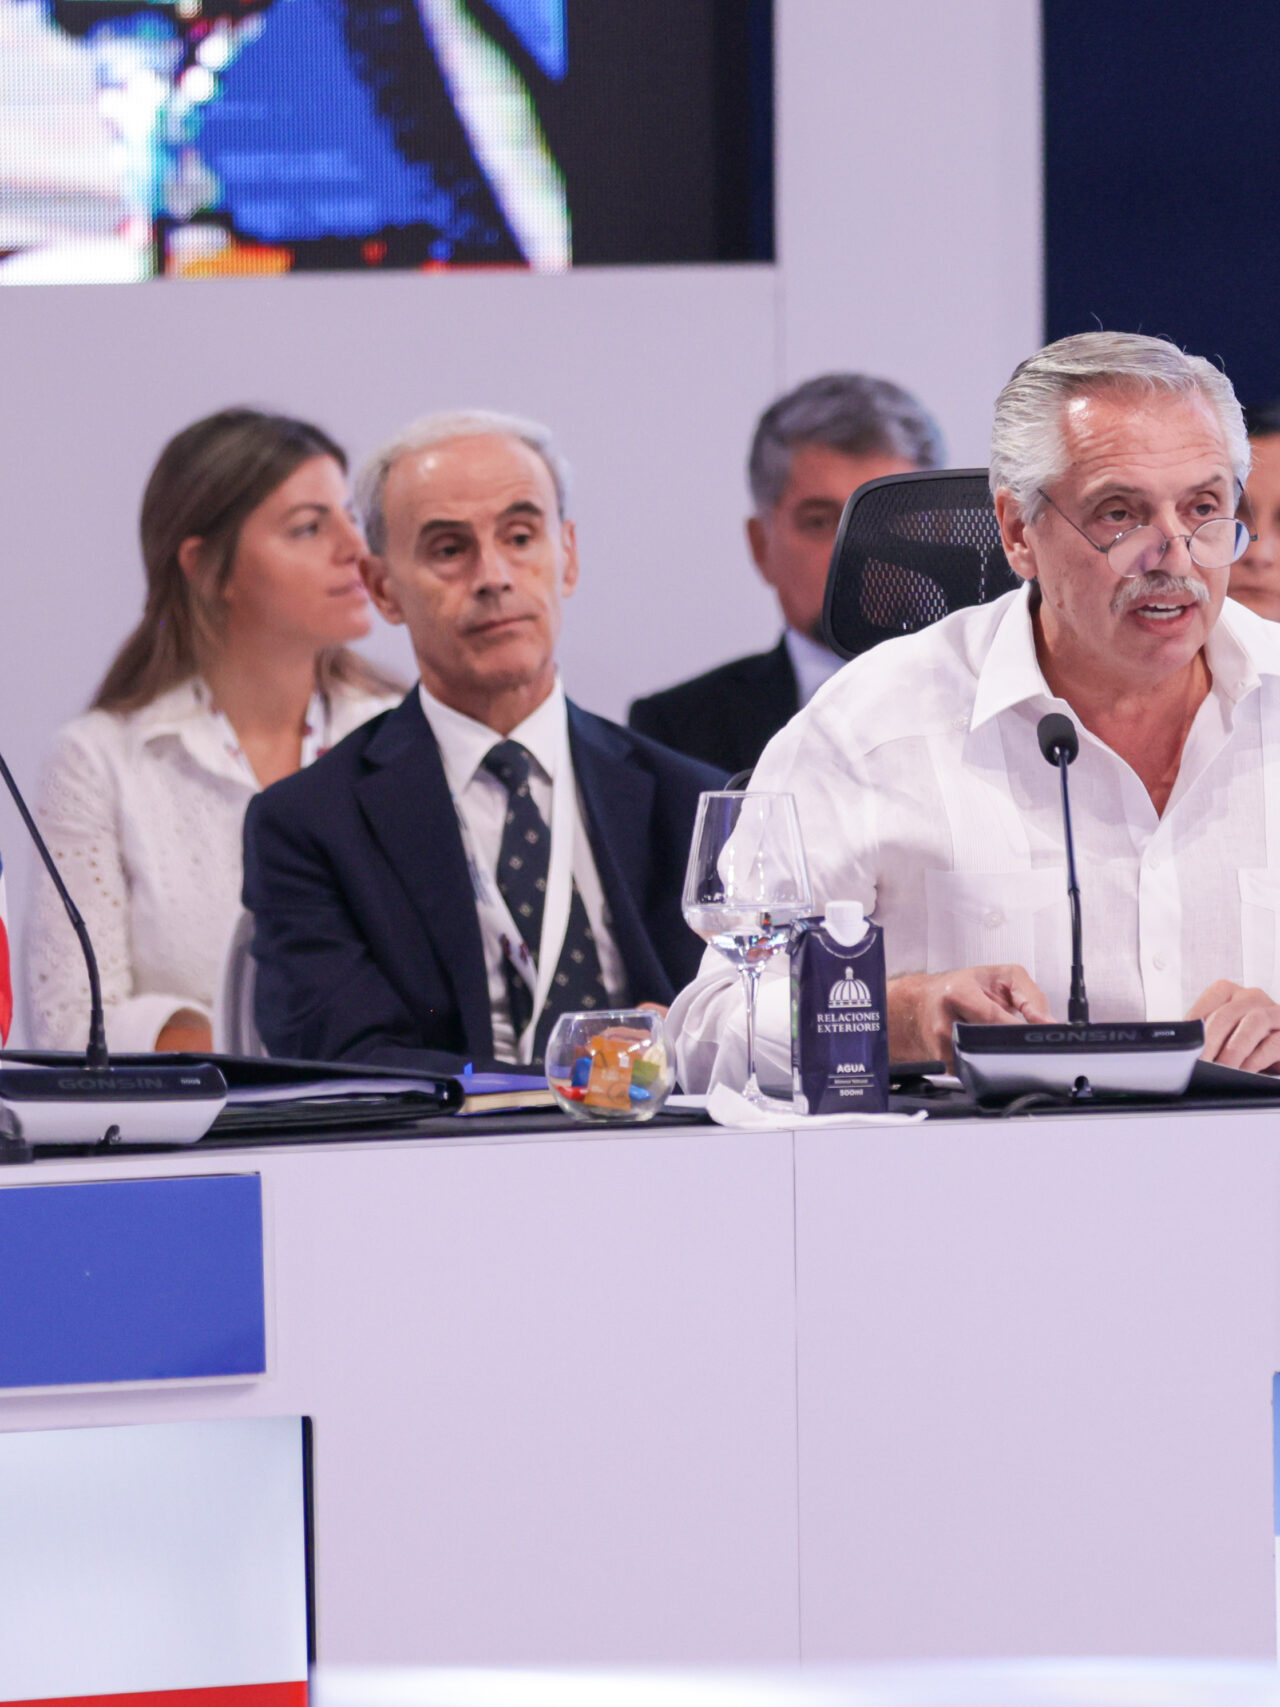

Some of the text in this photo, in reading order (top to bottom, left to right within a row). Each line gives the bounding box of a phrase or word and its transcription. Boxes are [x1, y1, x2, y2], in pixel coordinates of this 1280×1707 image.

[816, 1012, 880, 1023] RELACIONES
[817, 1022, 881, 1033] EXTERIORES
[1024, 1030, 1138, 1043] GONSIN
[836, 1063, 866, 1074] AGUA
[57, 1077, 163, 1090] GONSIN
